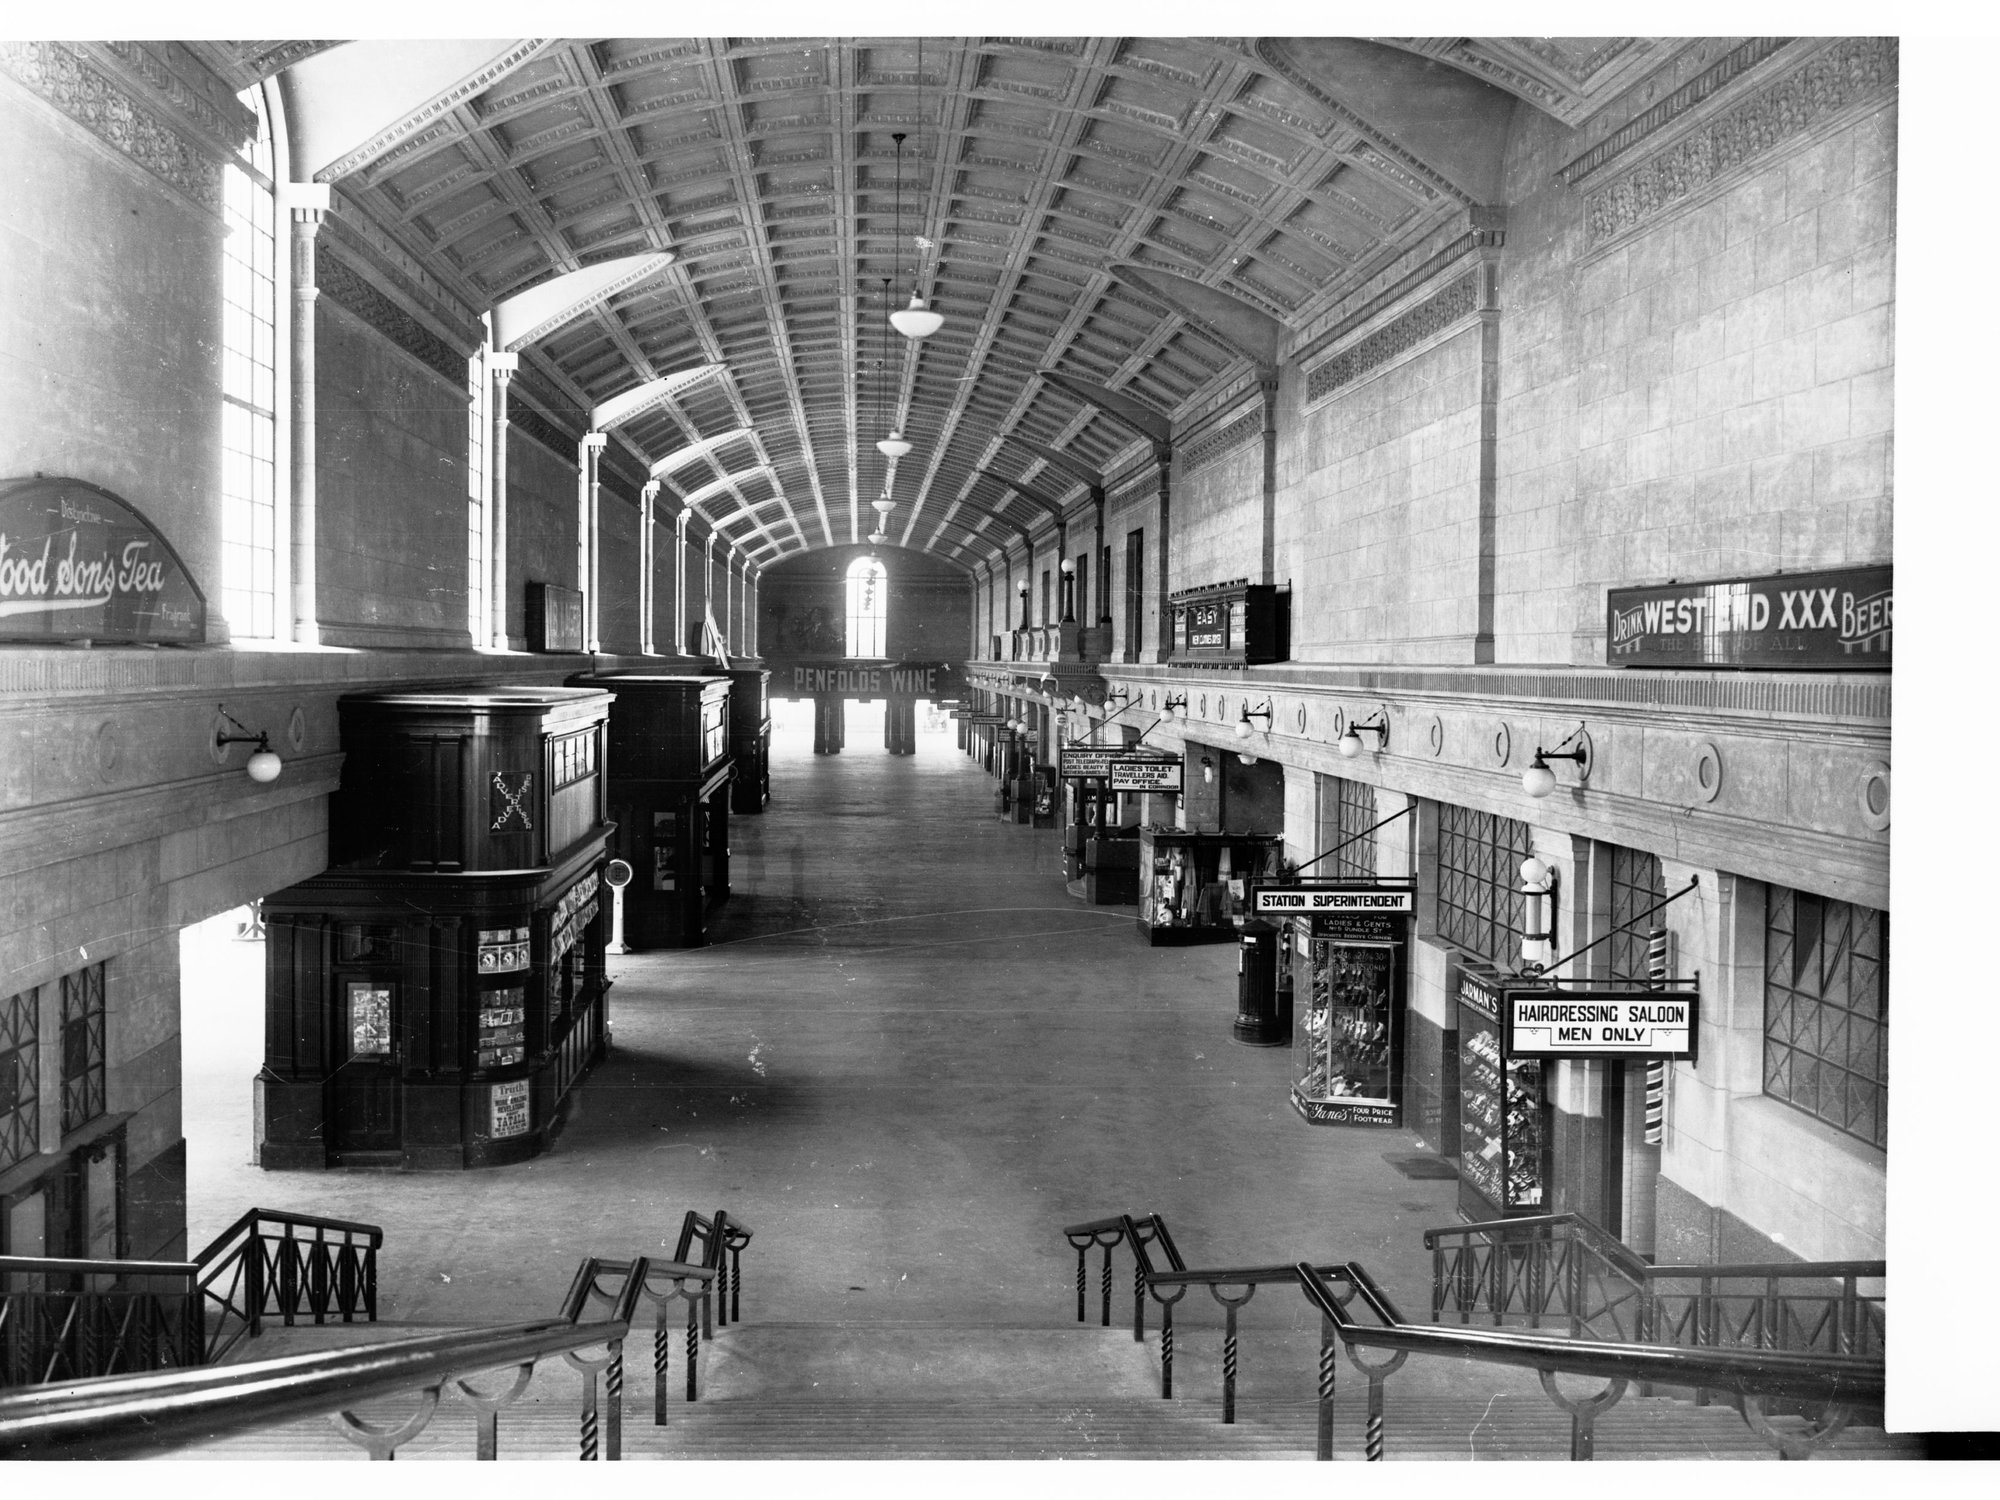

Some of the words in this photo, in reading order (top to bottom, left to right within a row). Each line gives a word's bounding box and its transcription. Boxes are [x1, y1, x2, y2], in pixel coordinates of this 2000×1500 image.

[54, 531, 116, 597] Son's
[119, 541, 165, 592] Tea
[1196, 609, 1218, 625] EASY
[1613, 608, 1645, 642] DRINK
[1644, 597, 1707, 634] WEST
[1778, 587, 1838, 630] XXX
[794, 667, 881, 692] PENFOLDS
[890, 668, 937, 693] WINE
[1263, 895, 1306, 907] STATION
[1313, 895, 1405, 907] SUPERINTENDENT
[1323, 918, 1353, 927] LADIES
[1460, 979, 1498, 1013] JARMAN'S
[1518, 1005, 1618, 1023] HAIRDRESSING
[1628, 1006, 1685, 1023] SALOON
[1558, 1028, 1592, 1041] MEN
[1602, 1028, 1645, 1042] ONLY
[1352, 1106, 1371, 1115] FOUR
[1372, 1107, 1394, 1116] PRICE
[1353, 1114, 1393, 1124] FOOTWEAR
